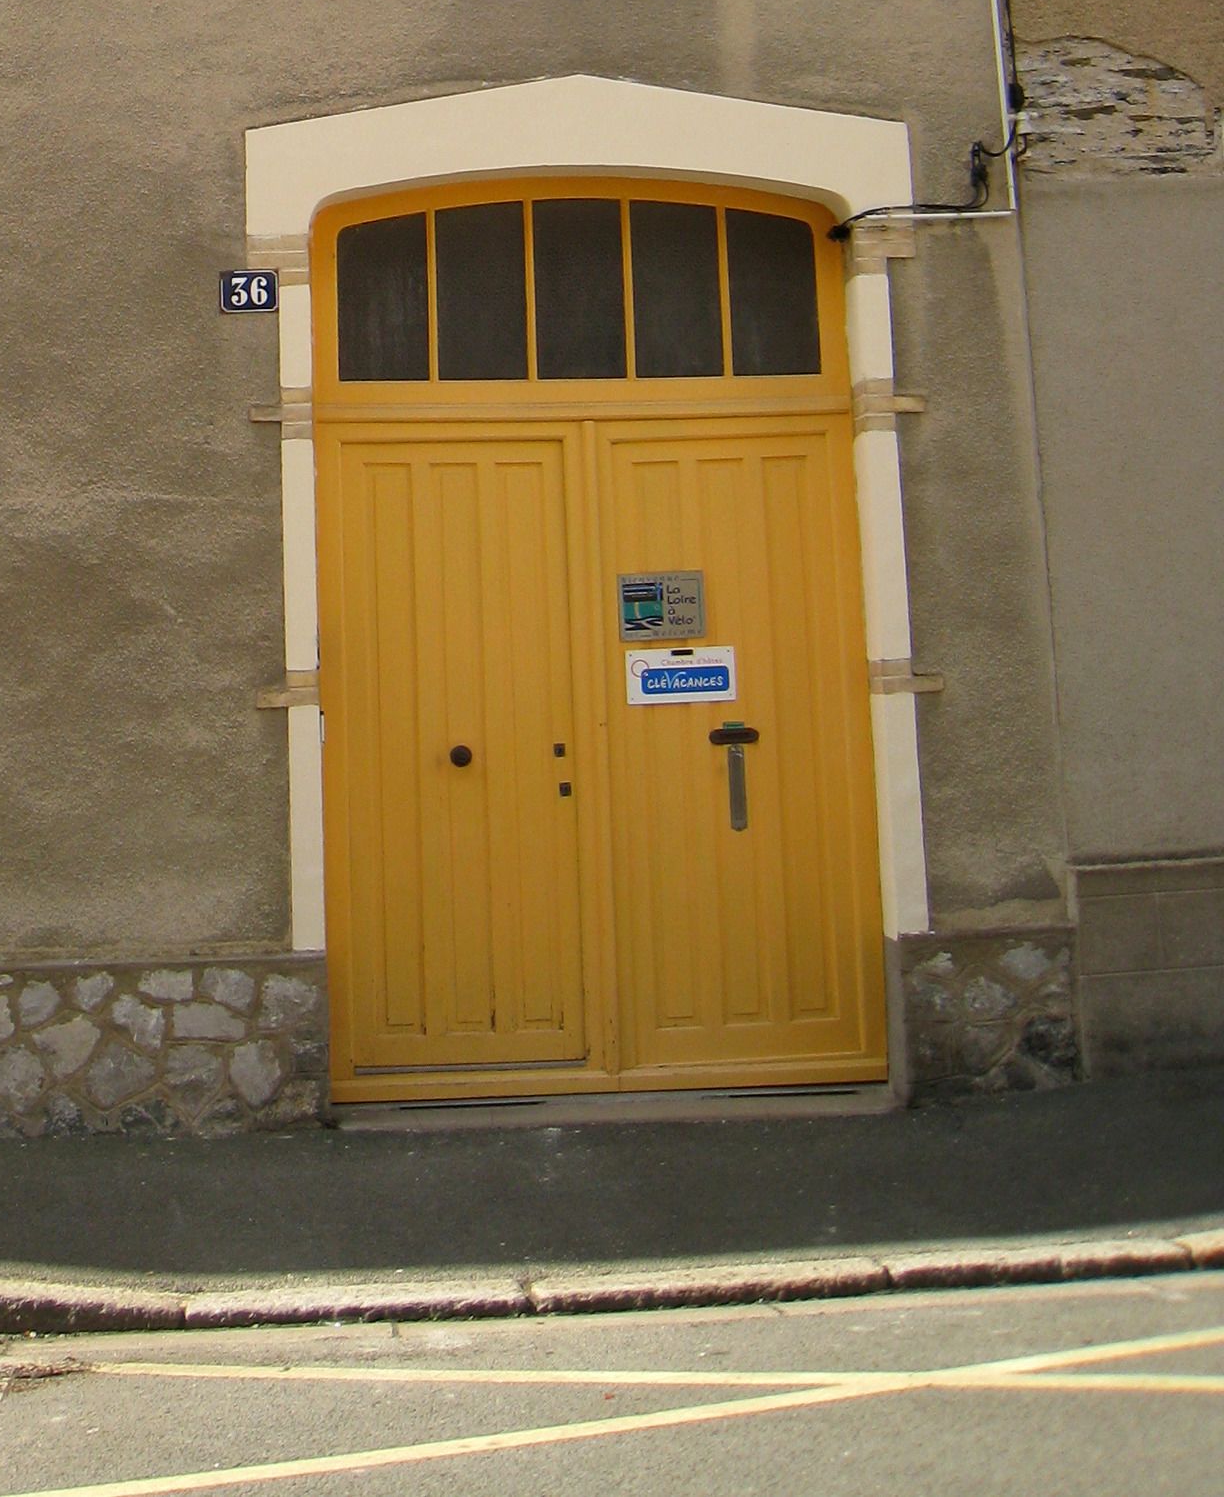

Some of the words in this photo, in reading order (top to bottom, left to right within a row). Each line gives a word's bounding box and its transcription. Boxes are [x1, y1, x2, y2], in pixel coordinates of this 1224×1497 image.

[231, 276, 268, 306] 36
[666, 585, 680, 594] La
[667, 595, 697, 605] Loire
[667, 605, 676, 616] à
